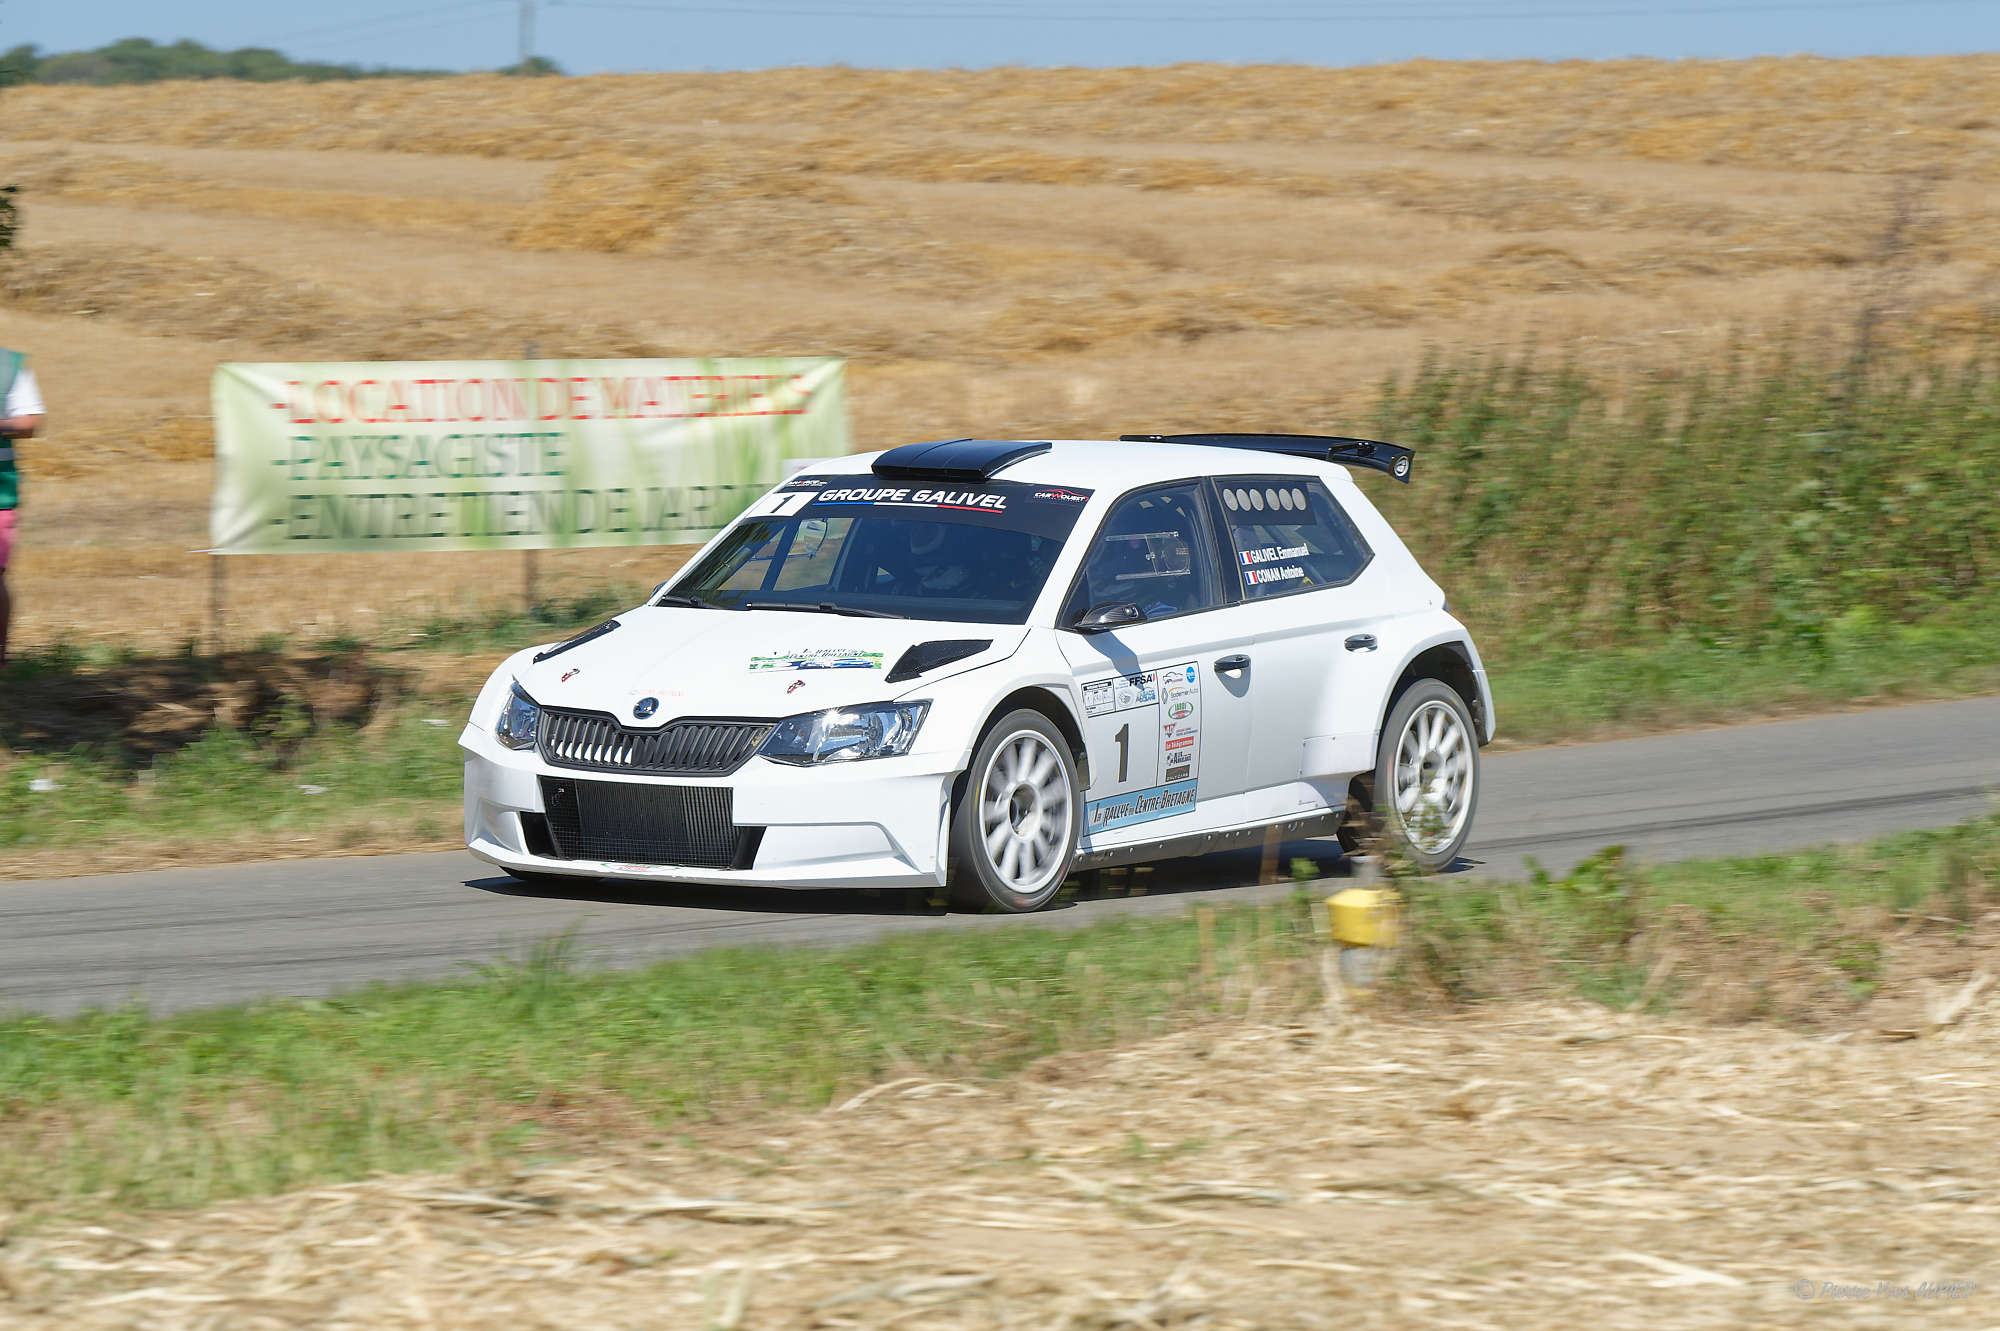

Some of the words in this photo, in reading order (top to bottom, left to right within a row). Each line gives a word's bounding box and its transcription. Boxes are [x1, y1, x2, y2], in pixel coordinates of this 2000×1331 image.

[770, 493, 795, 514] 1
[818, 488, 911, 504] GROUPE
[912, 489, 1008, 510] GALIVEL
[1251, 547, 1279, 563] GALIVEL
[1278, 543, 1310, 559] Emmanuel
[1257, 568, 1281, 583] CONAN
[1280, 565, 1305, 580] Antoine
[1129, 673, 1153, 687] FFSA
[1114, 723, 1129, 783] 1
[1102, 804, 1130, 827] RALLYE
